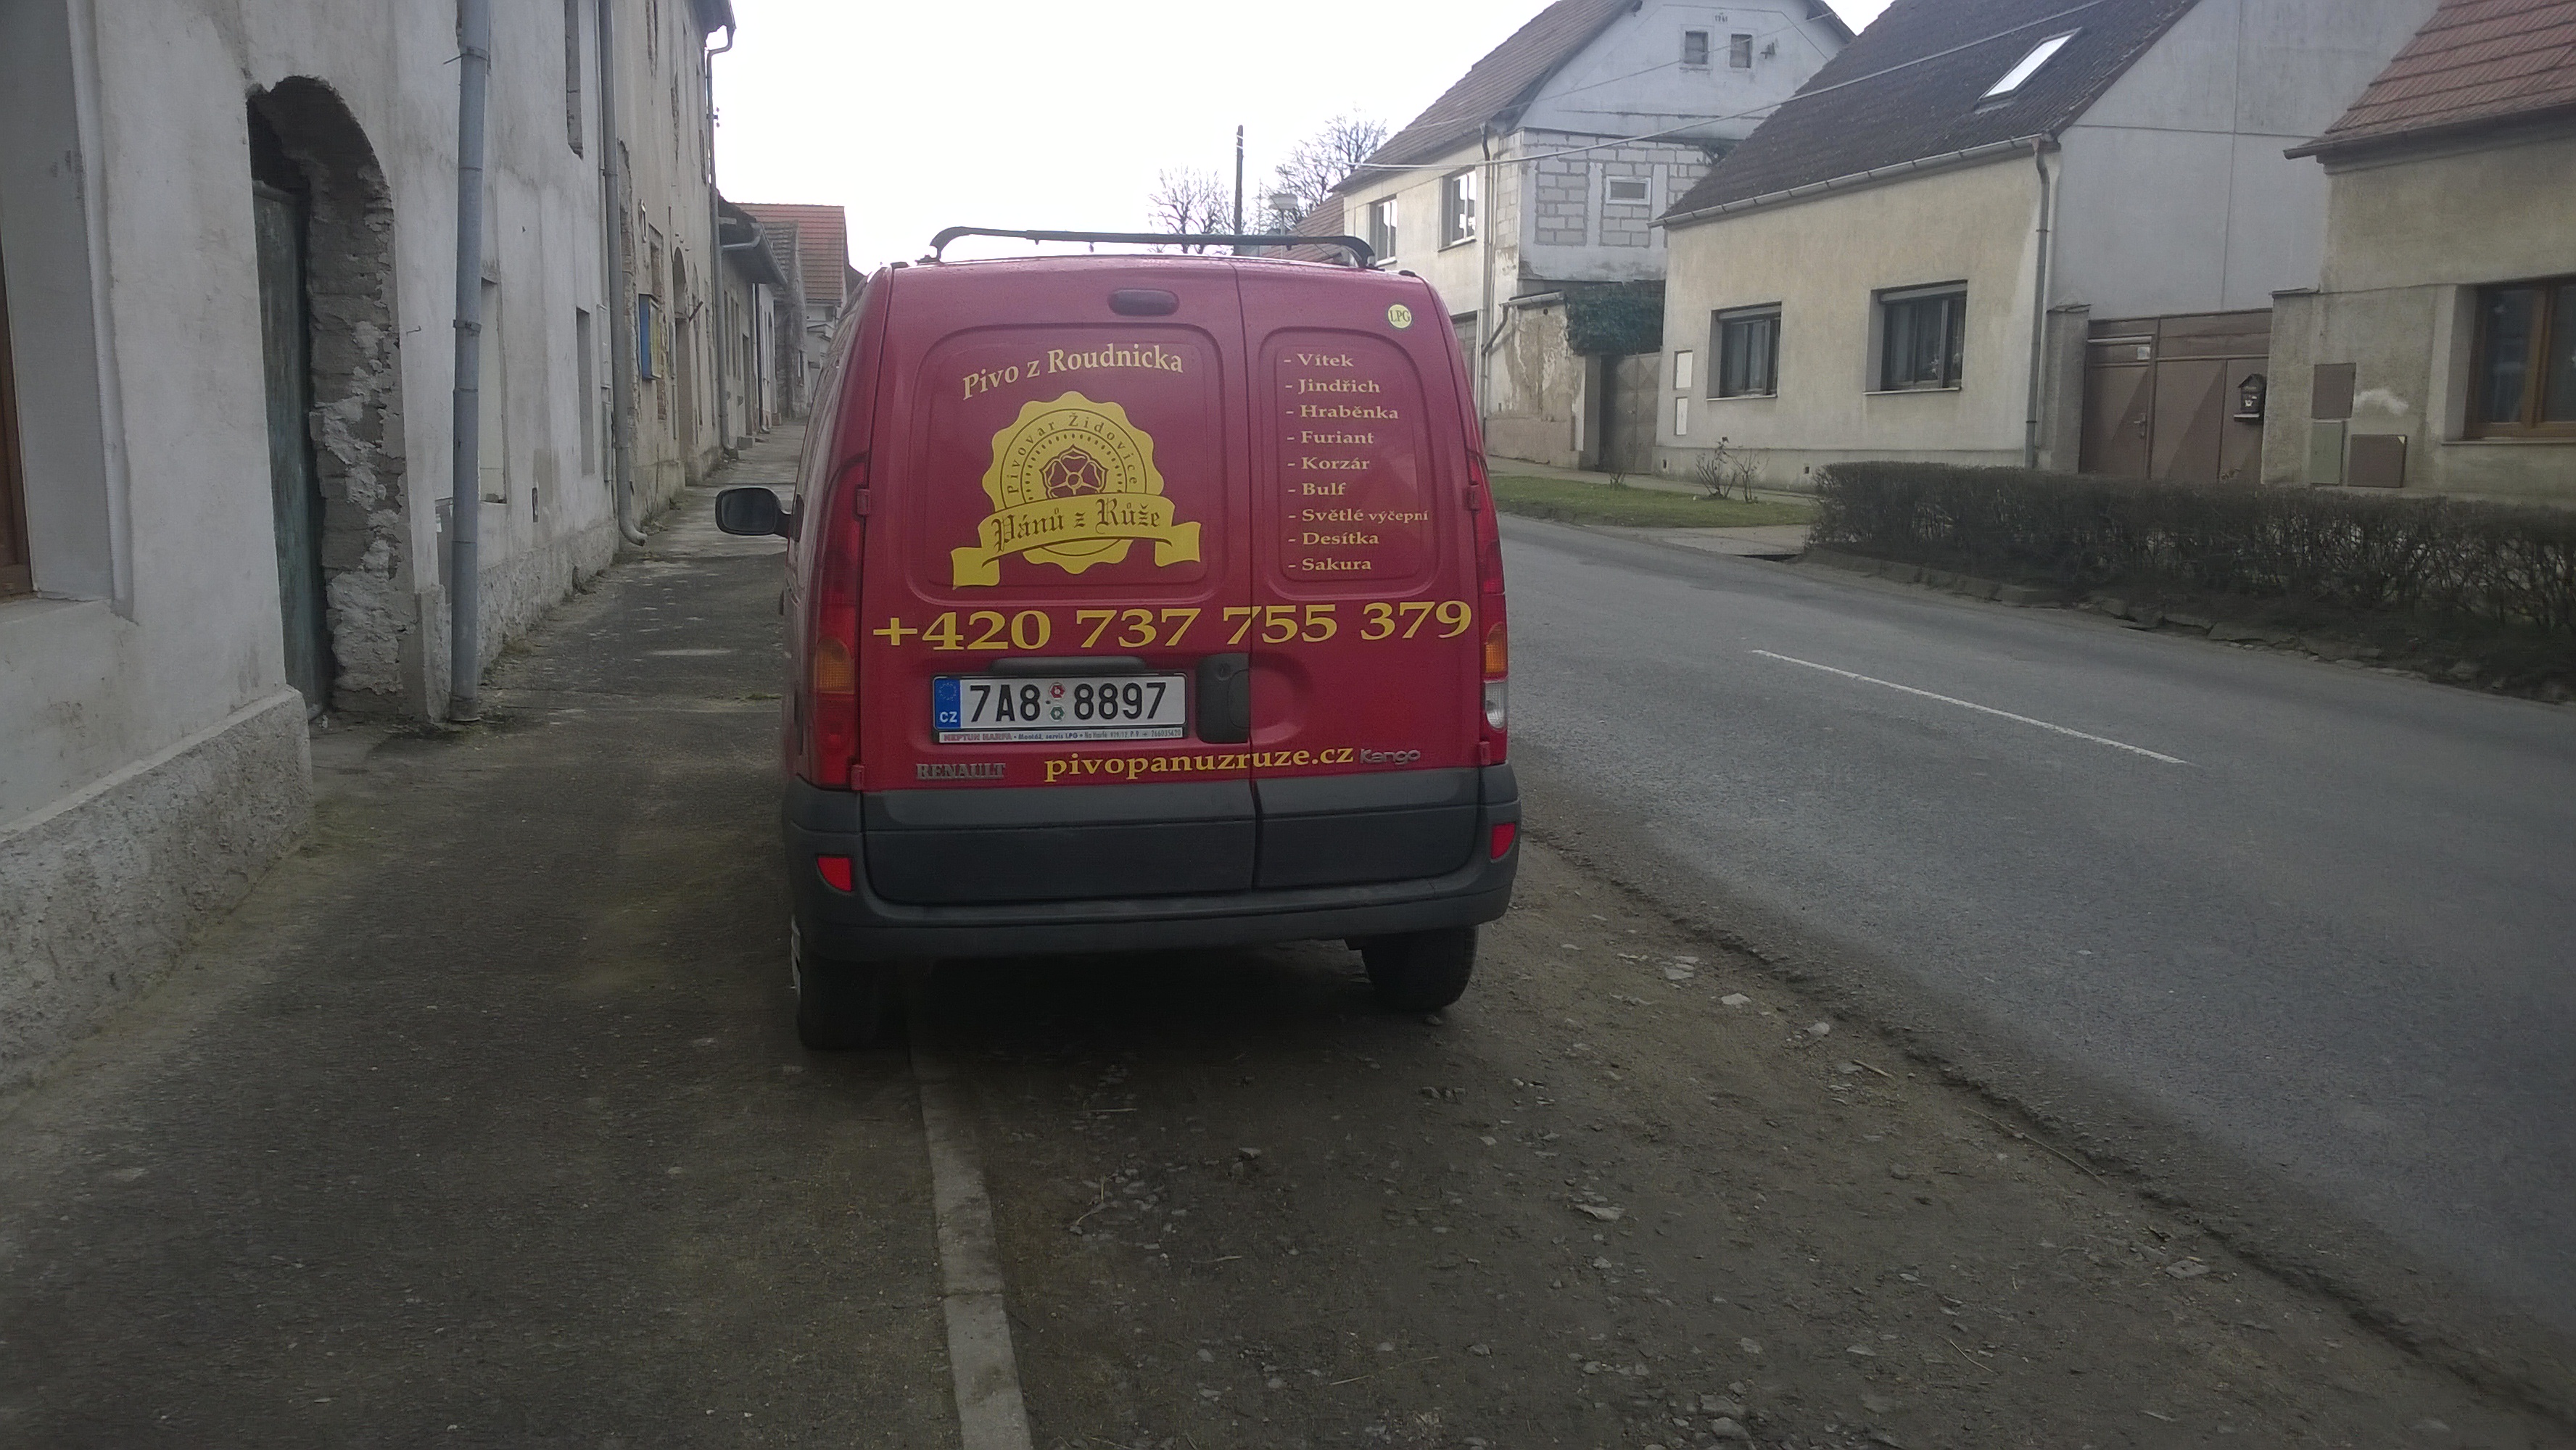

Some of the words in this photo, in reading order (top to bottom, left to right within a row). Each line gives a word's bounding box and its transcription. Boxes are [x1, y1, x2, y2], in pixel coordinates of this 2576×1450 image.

[1390, 310, 1411, 323] LPG
[1297, 353, 1354, 368] Vítek
[962, 364, 1019, 400] Pivo
[1027, 360, 1040, 378] z
[1047, 343, 1184, 374] Roudnicka
[1298, 378, 1381, 395] Jindřich
[1300, 405, 1399, 420] Hraběnka
[1300, 431, 1374, 444] Furiant
[1007, 421, 1054, 494] Pivovar
[1068, 412, 1138, 484] Židovice
[1302, 456, 1370, 471] Korzár
[1302, 482, 1347, 496] Bulf
[1302, 508, 1364, 522] Světlé
[1368, 510, 1429, 525] výčepní
[991, 508, 1064, 553] Pánů
[1074, 512, 1086, 529] z
[1095, 497, 1160, 534] Růže
[1303, 531, 1379, 545] Desítka
[1302, 558, 1372, 571] Sakura
[873, 610, 1052, 650] +420
[1076, 608, 1201, 647] 737
[1223, 603, 1337, 645] 755
[1360, 601, 1472, 640] 379
[970, 684, 1041, 723] 7A8
[1074, 682, 1167, 721] 8897
[939, 711, 958, 724] CZ
[916, 762, 1006, 780] RENAULT
[1044, 747, 1354, 782] pivopanuzruze.cz
